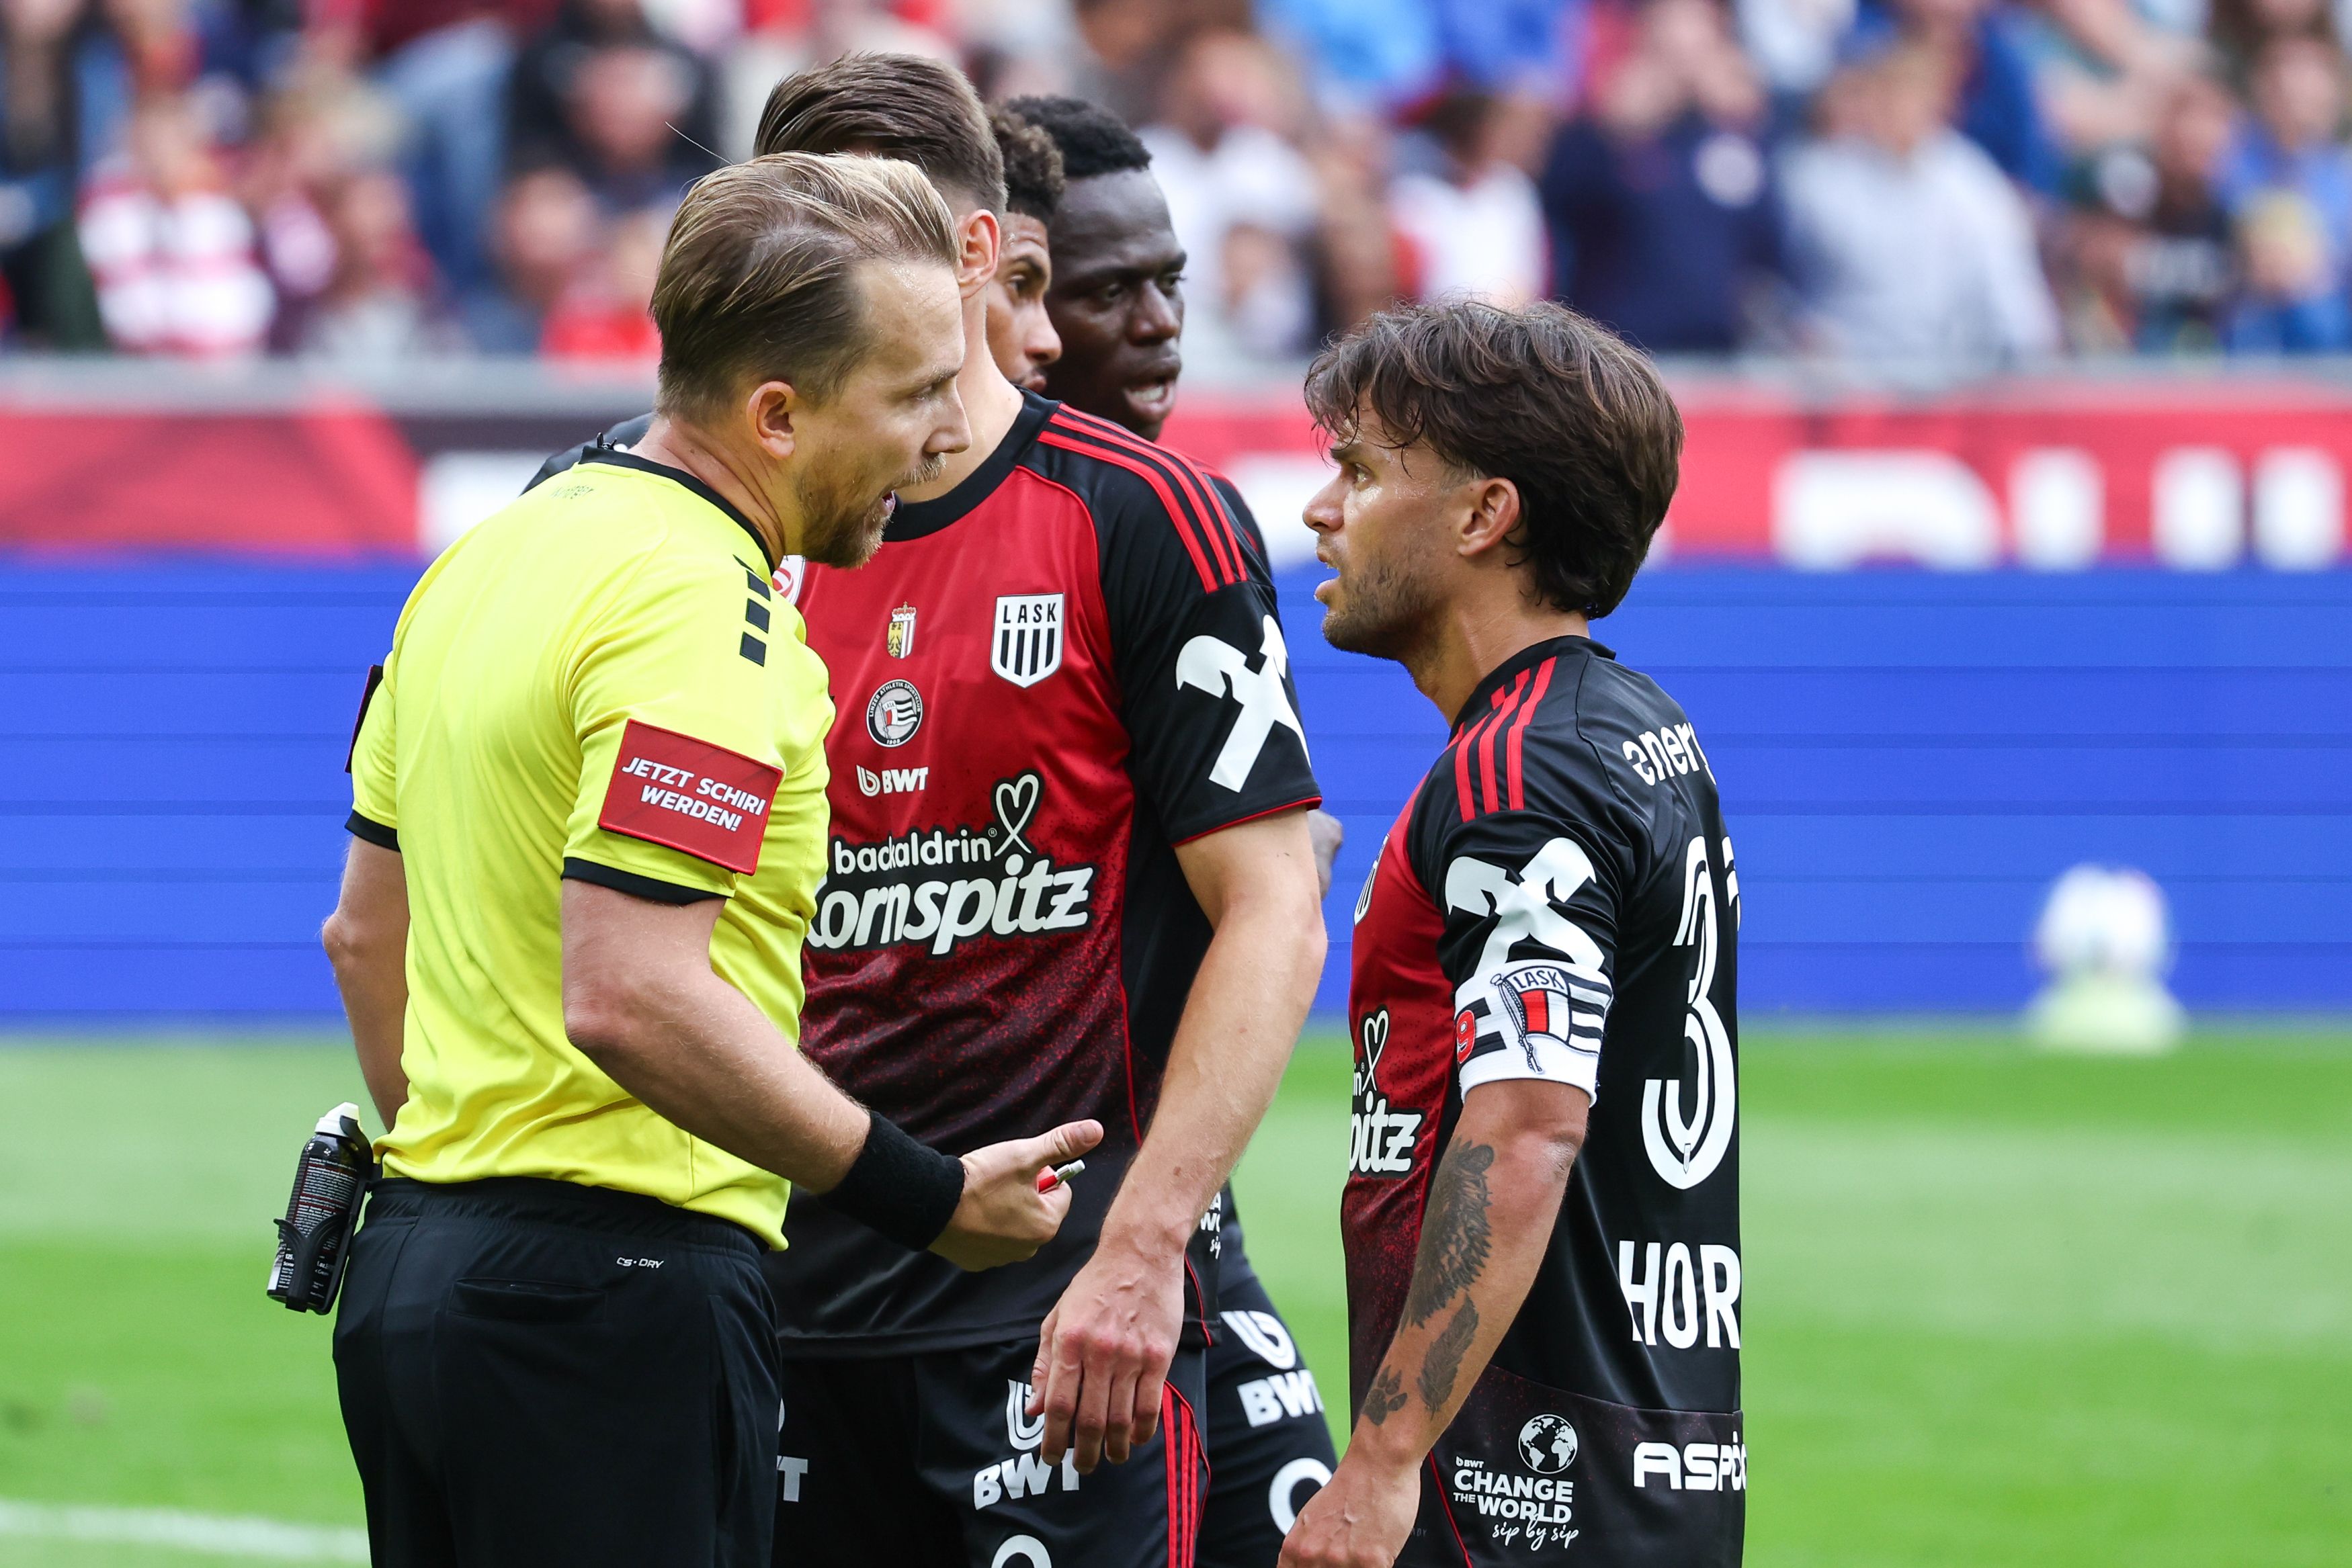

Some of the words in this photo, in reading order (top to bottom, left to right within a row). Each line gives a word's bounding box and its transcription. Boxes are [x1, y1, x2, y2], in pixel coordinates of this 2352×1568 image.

[1003, 603, 1056, 623] LASK
[869, 694, 880, 717] LINZER
[880, 682, 904, 695] ATHLETIK
[622, 757, 695, 787] JETZT
[696, 777, 766, 816] SCHIRI
[882, 766, 929, 794] BWT
[640, 785, 742, 832] WERDEN!
[1513, 969, 1566, 991] LASK
[1618, 1240, 1741, 1349] HOR
[1464, 1460, 1484, 1469] BWT
[1454, 1469, 1574, 1503] CHANGE
[1453, 1492, 1476, 1504] THE
[1477, 1494, 1572, 1524] WORLD
[1492, 1522, 1520, 1547] sip
[1525, 1513, 1548, 1551] by
[1550, 1524, 1579, 1549] sip
